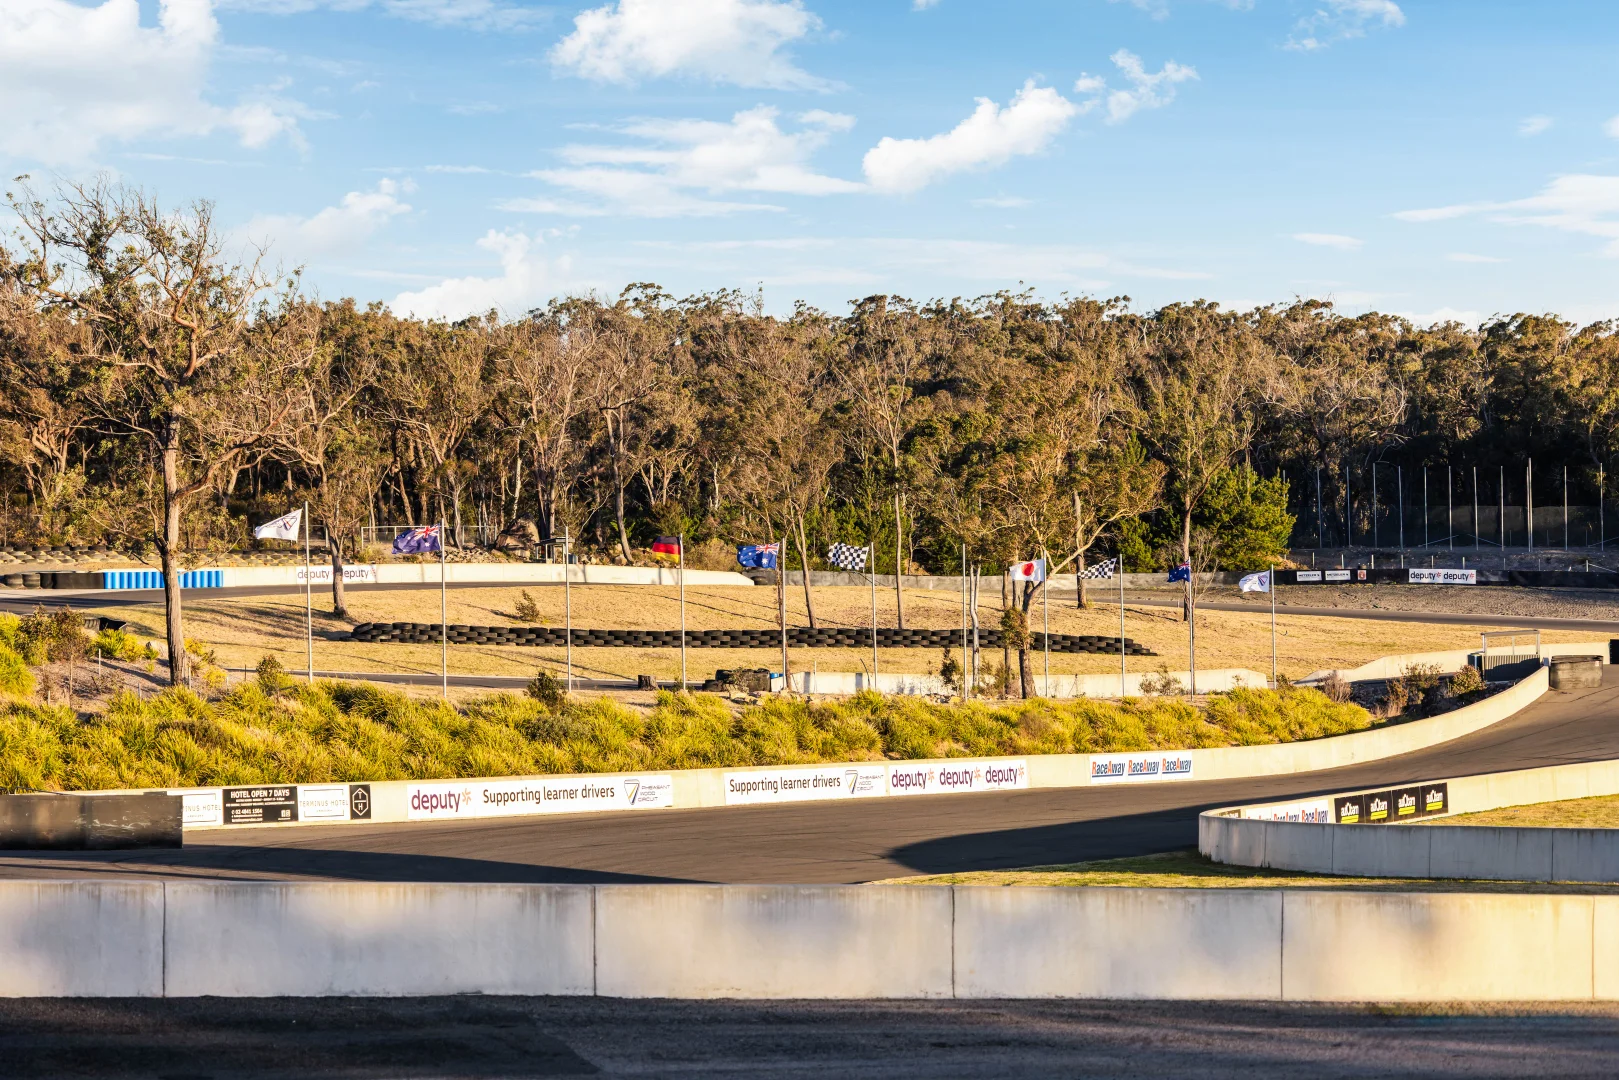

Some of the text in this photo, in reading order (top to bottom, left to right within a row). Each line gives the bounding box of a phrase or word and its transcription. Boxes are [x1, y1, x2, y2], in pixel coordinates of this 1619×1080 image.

[297, 569, 369, 580] deputy eputy
[1410, 571, 1470, 581] deputy deputy
[1091, 757, 1192, 775] RaceAway RaceAway RaceAway
[729, 774, 841, 795] Supporting learner drivers
[891, 765, 1018, 790] deputy deputy deputy
[230, 790, 250, 799] HOTEL
[251, 790, 268, 798] OPEN
[273, 789, 290, 797] DAYS
[411, 789, 461, 813] deputy
[483, 783, 615, 806] Supporting learner drivers
[182, 804, 200, 812] INUS
